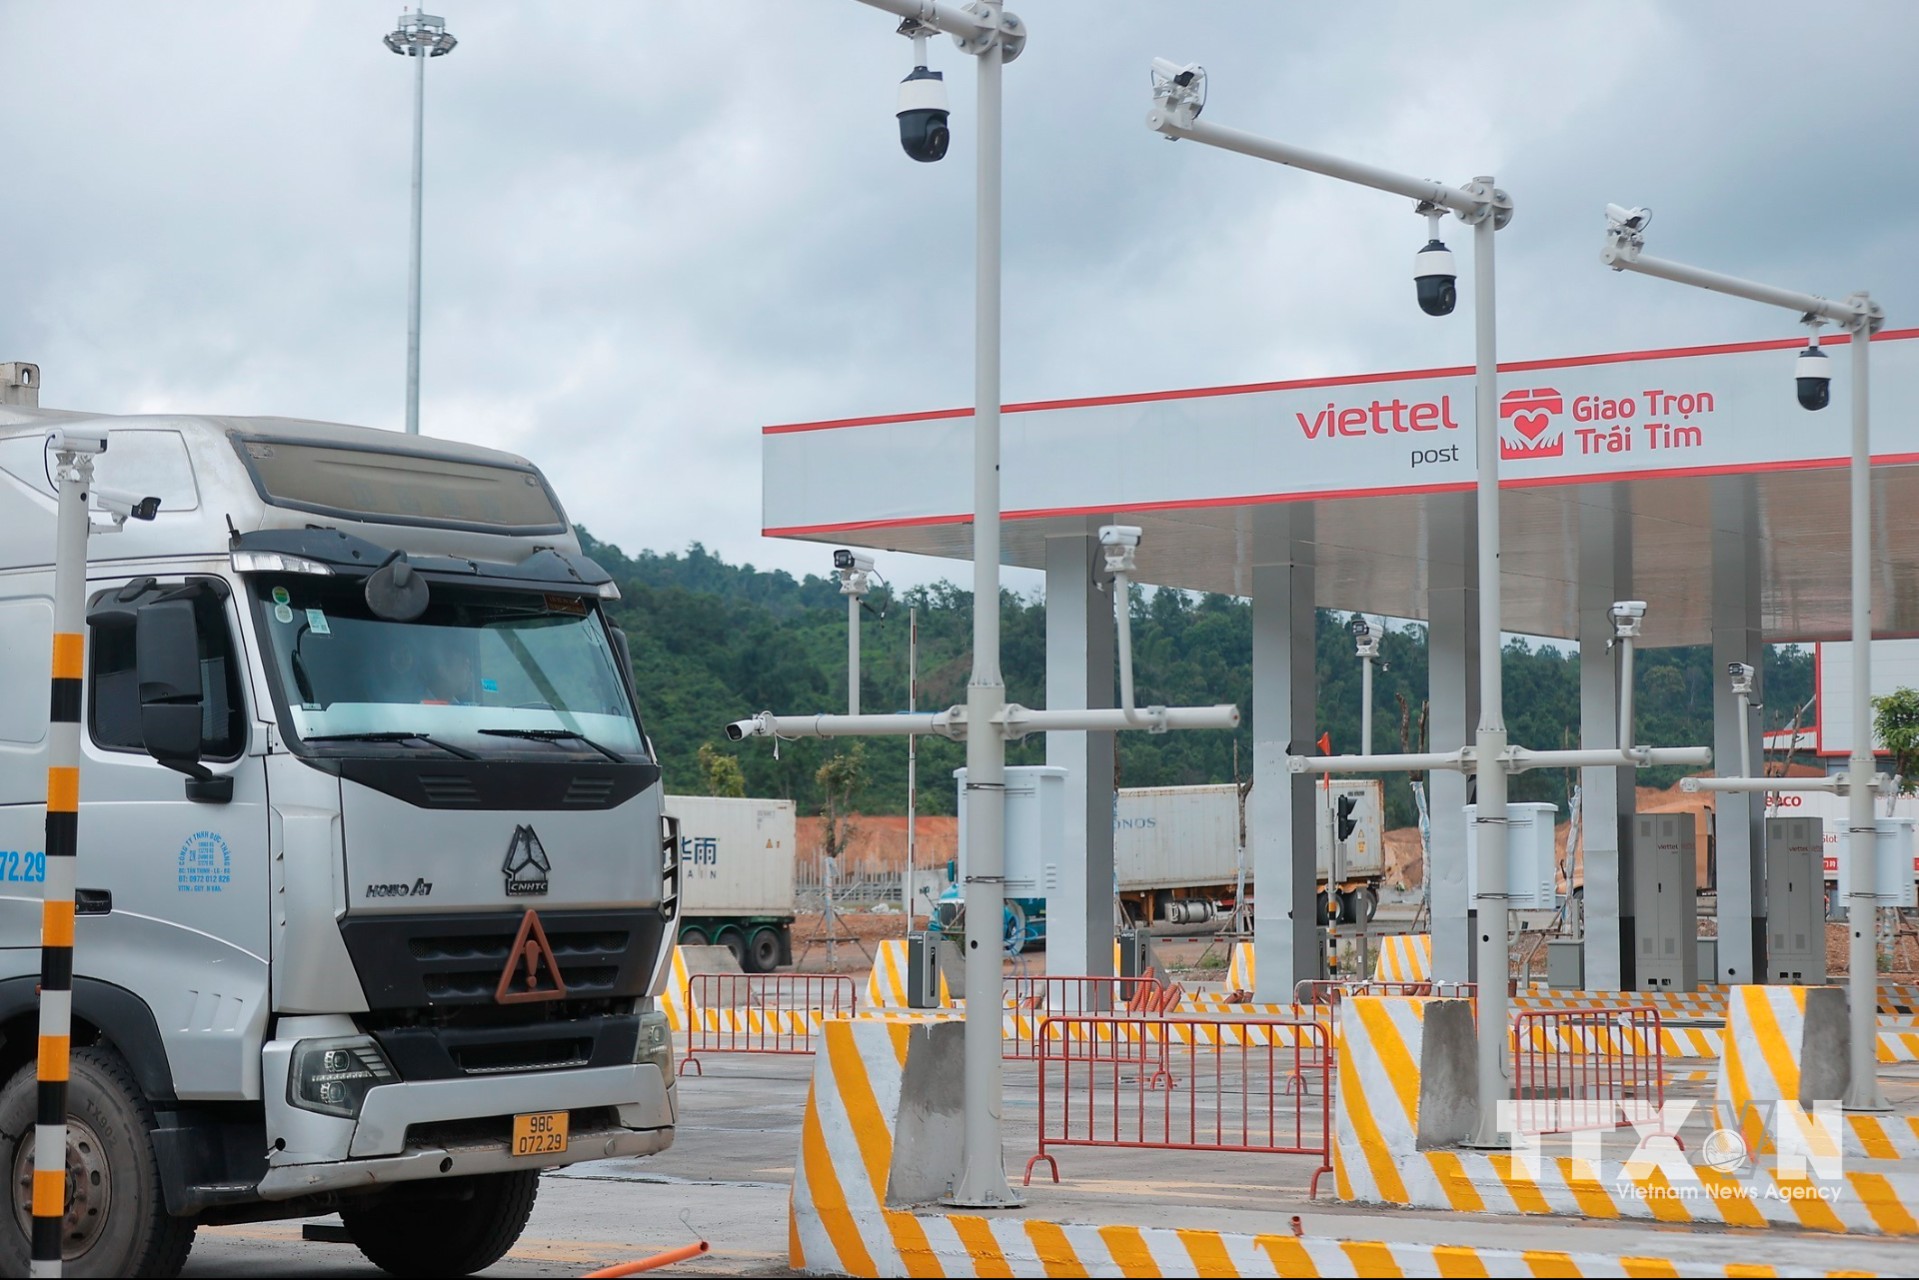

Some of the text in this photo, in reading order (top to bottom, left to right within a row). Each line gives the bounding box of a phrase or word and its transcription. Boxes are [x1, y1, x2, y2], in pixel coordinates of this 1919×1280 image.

[1296, 395, 1458, 440] viettel
[1572, 388, 1715, 423] Giao Trọn
[1574, 425, 1702, 456] Trái Tim
[1411, 443, 1460, 468] post
[510, 881, 548, 892] CNHTC
[530, 1115, 554, 1133] 98C
[519, 1133, 562, 1153] 072.29
